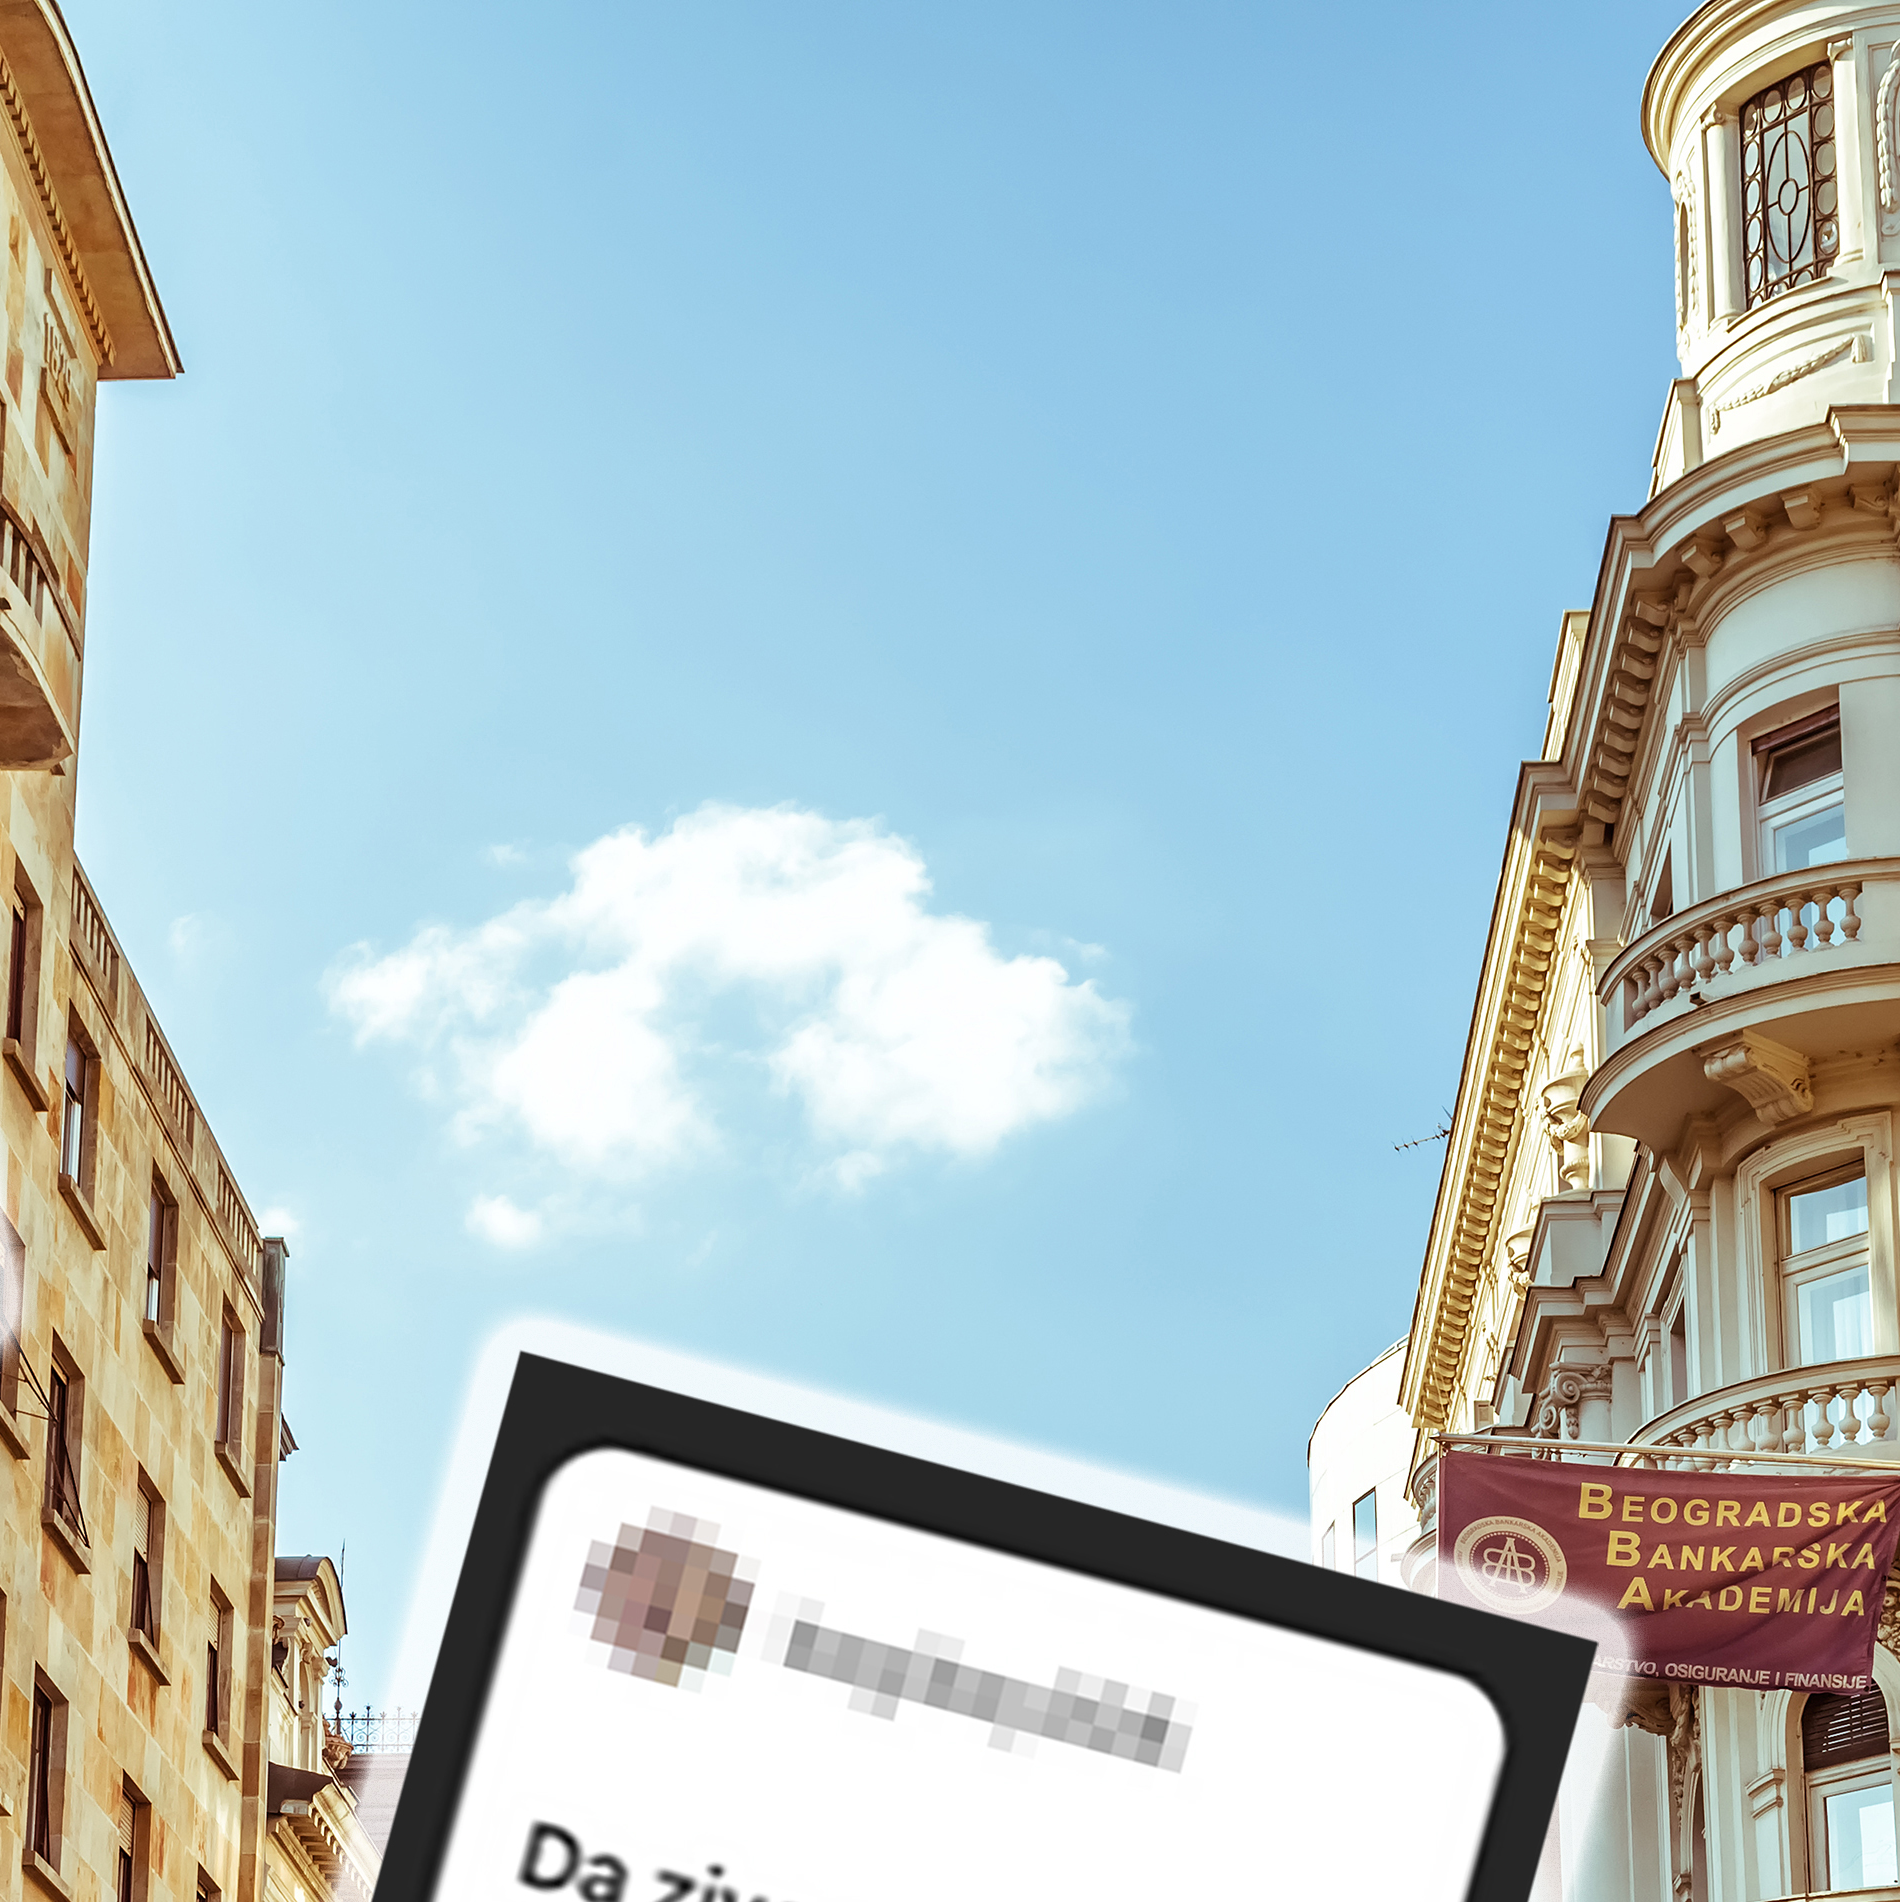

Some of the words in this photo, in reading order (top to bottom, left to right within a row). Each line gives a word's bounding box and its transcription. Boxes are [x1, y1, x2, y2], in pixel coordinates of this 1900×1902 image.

[1578, 1482, 1888, 1528] BEOGRADSKA
[1494, 1518, 1536, 1534] BANKARSKA
[1606, 1530, 1876, 1572] BANKARSKA
[1617, 1576, 1866, 1617] AKADEMIJA
[1664, 1662, 1771, 1686] OSIGURANJE
[1784, 1672, 1868, 1690] FINANSIJE
